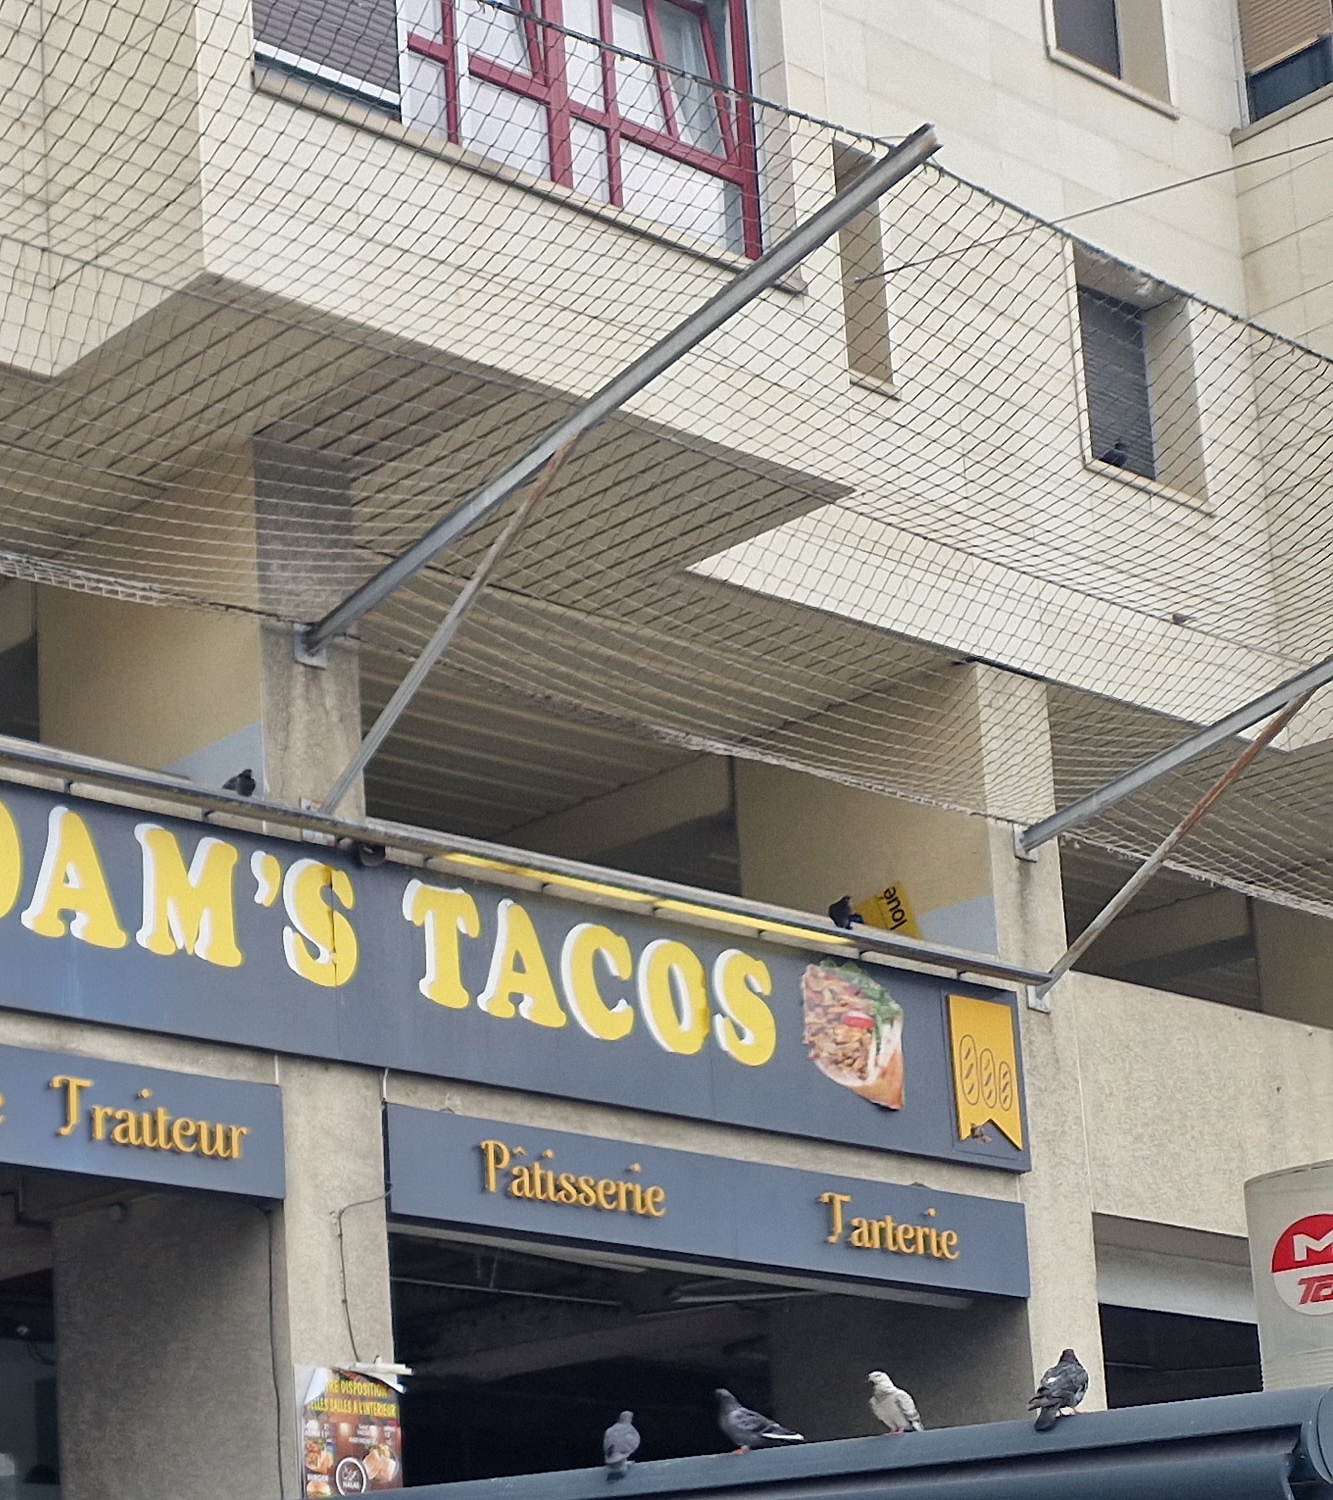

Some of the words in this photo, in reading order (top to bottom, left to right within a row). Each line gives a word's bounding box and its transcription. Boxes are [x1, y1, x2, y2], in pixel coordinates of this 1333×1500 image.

[402, 878, 777, 1067] TACOS
[50, 1074, 250, 1160] Traiteur
[479, 1140, 667, 1218] Pâtisserie
[818, 1192, 961, 1261] Tarterie
